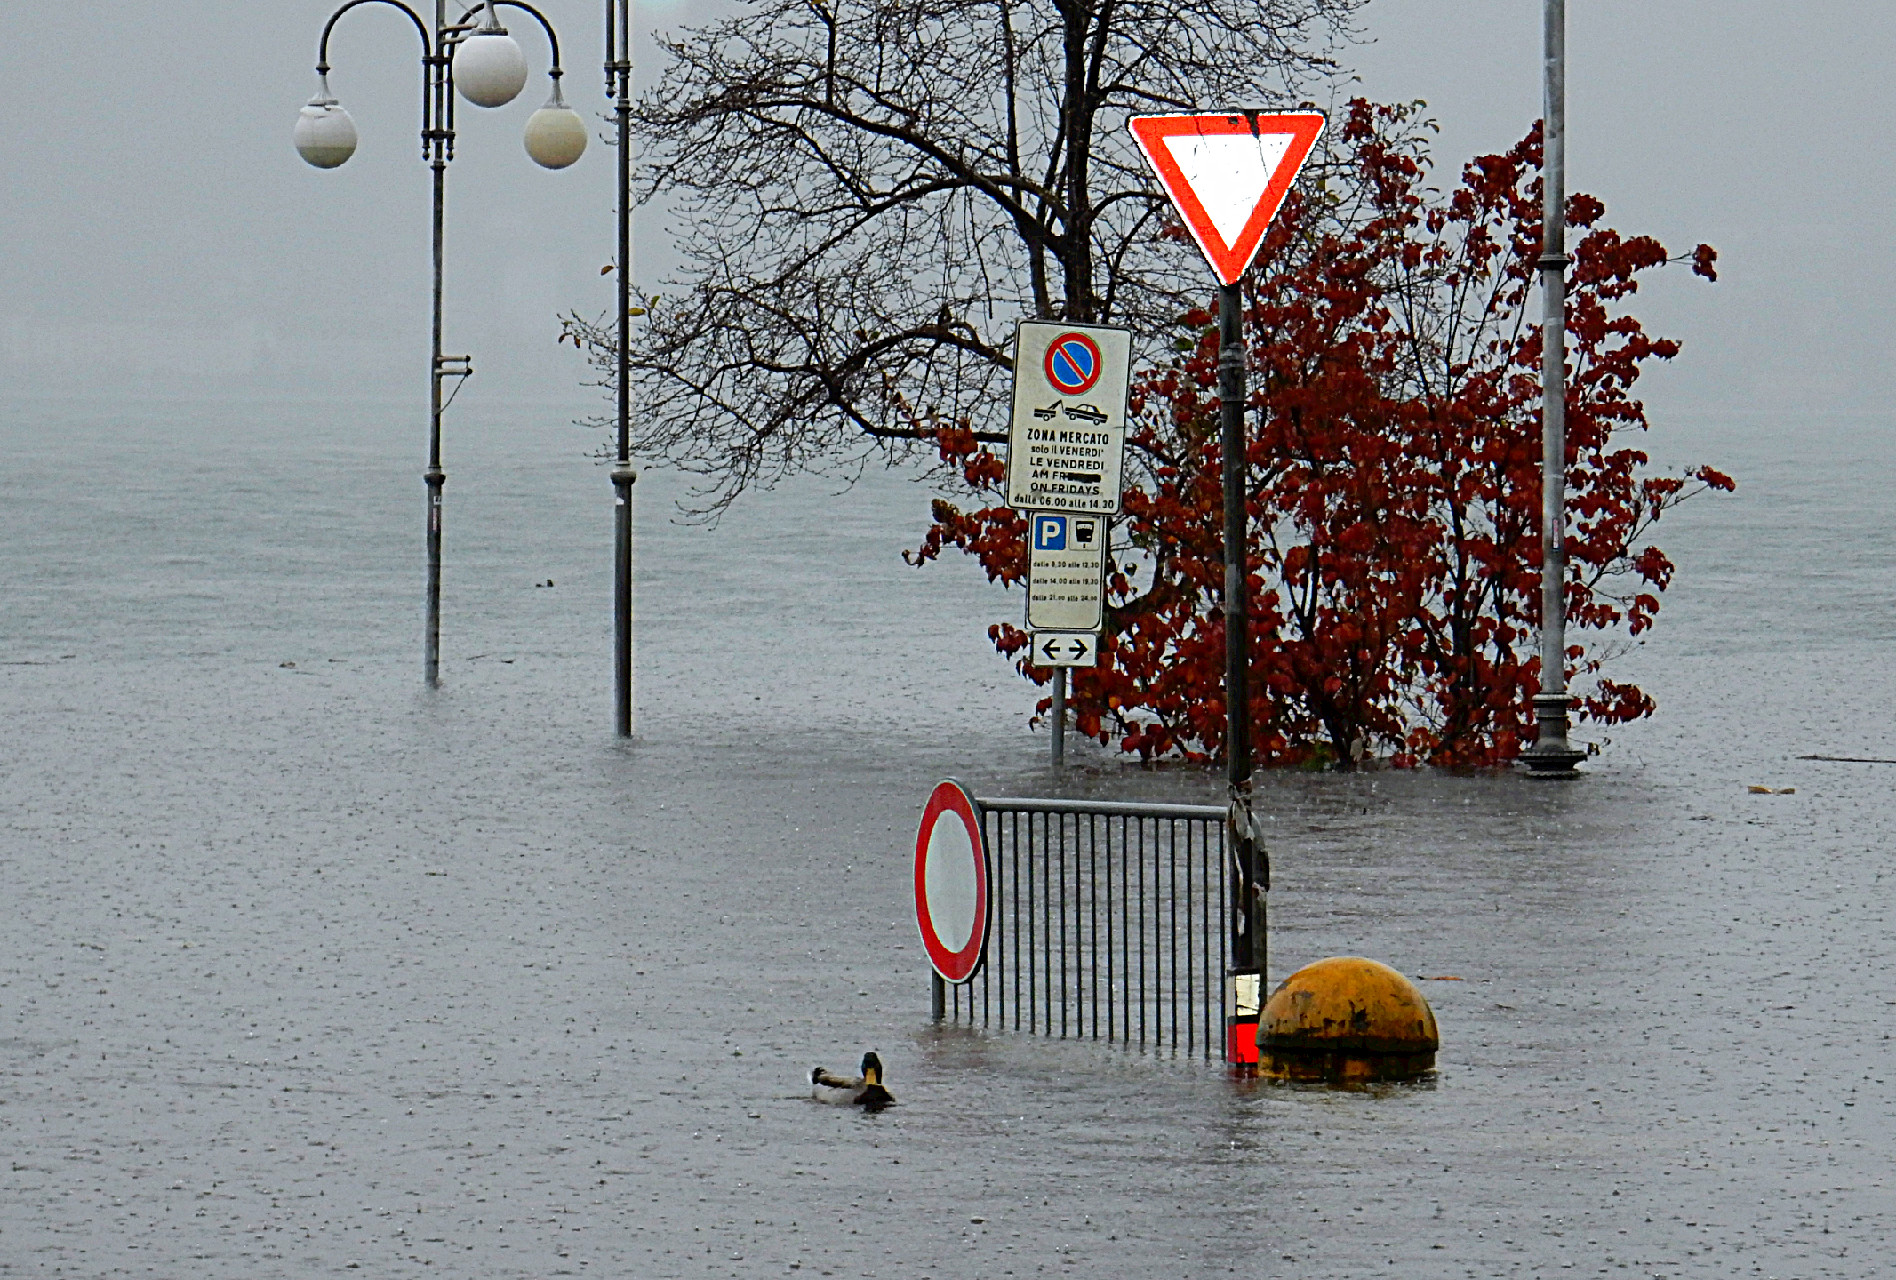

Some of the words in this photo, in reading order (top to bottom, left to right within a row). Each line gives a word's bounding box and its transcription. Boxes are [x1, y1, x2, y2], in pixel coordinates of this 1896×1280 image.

[1027, 428, 1055, 442] ZONA
[1060, 431, 1109, 445] MERCATO
[1030, 445, 1049, 453] solo
[1051, 445, 1057, 454] il
[1030, 457, 1043, 466] LE
[1047, 458, 1104, 470] VENDREDI
[1032, 469, 1048, 478] AM
[1030, 483, 1047, 492] ON
[1052, 484, 1100, 495] FRIDAYS
[1014, 493, 1037, 504] dalle
[1069, 498, 1086, 508] alle
[1041, 521, 1060, 546] P
